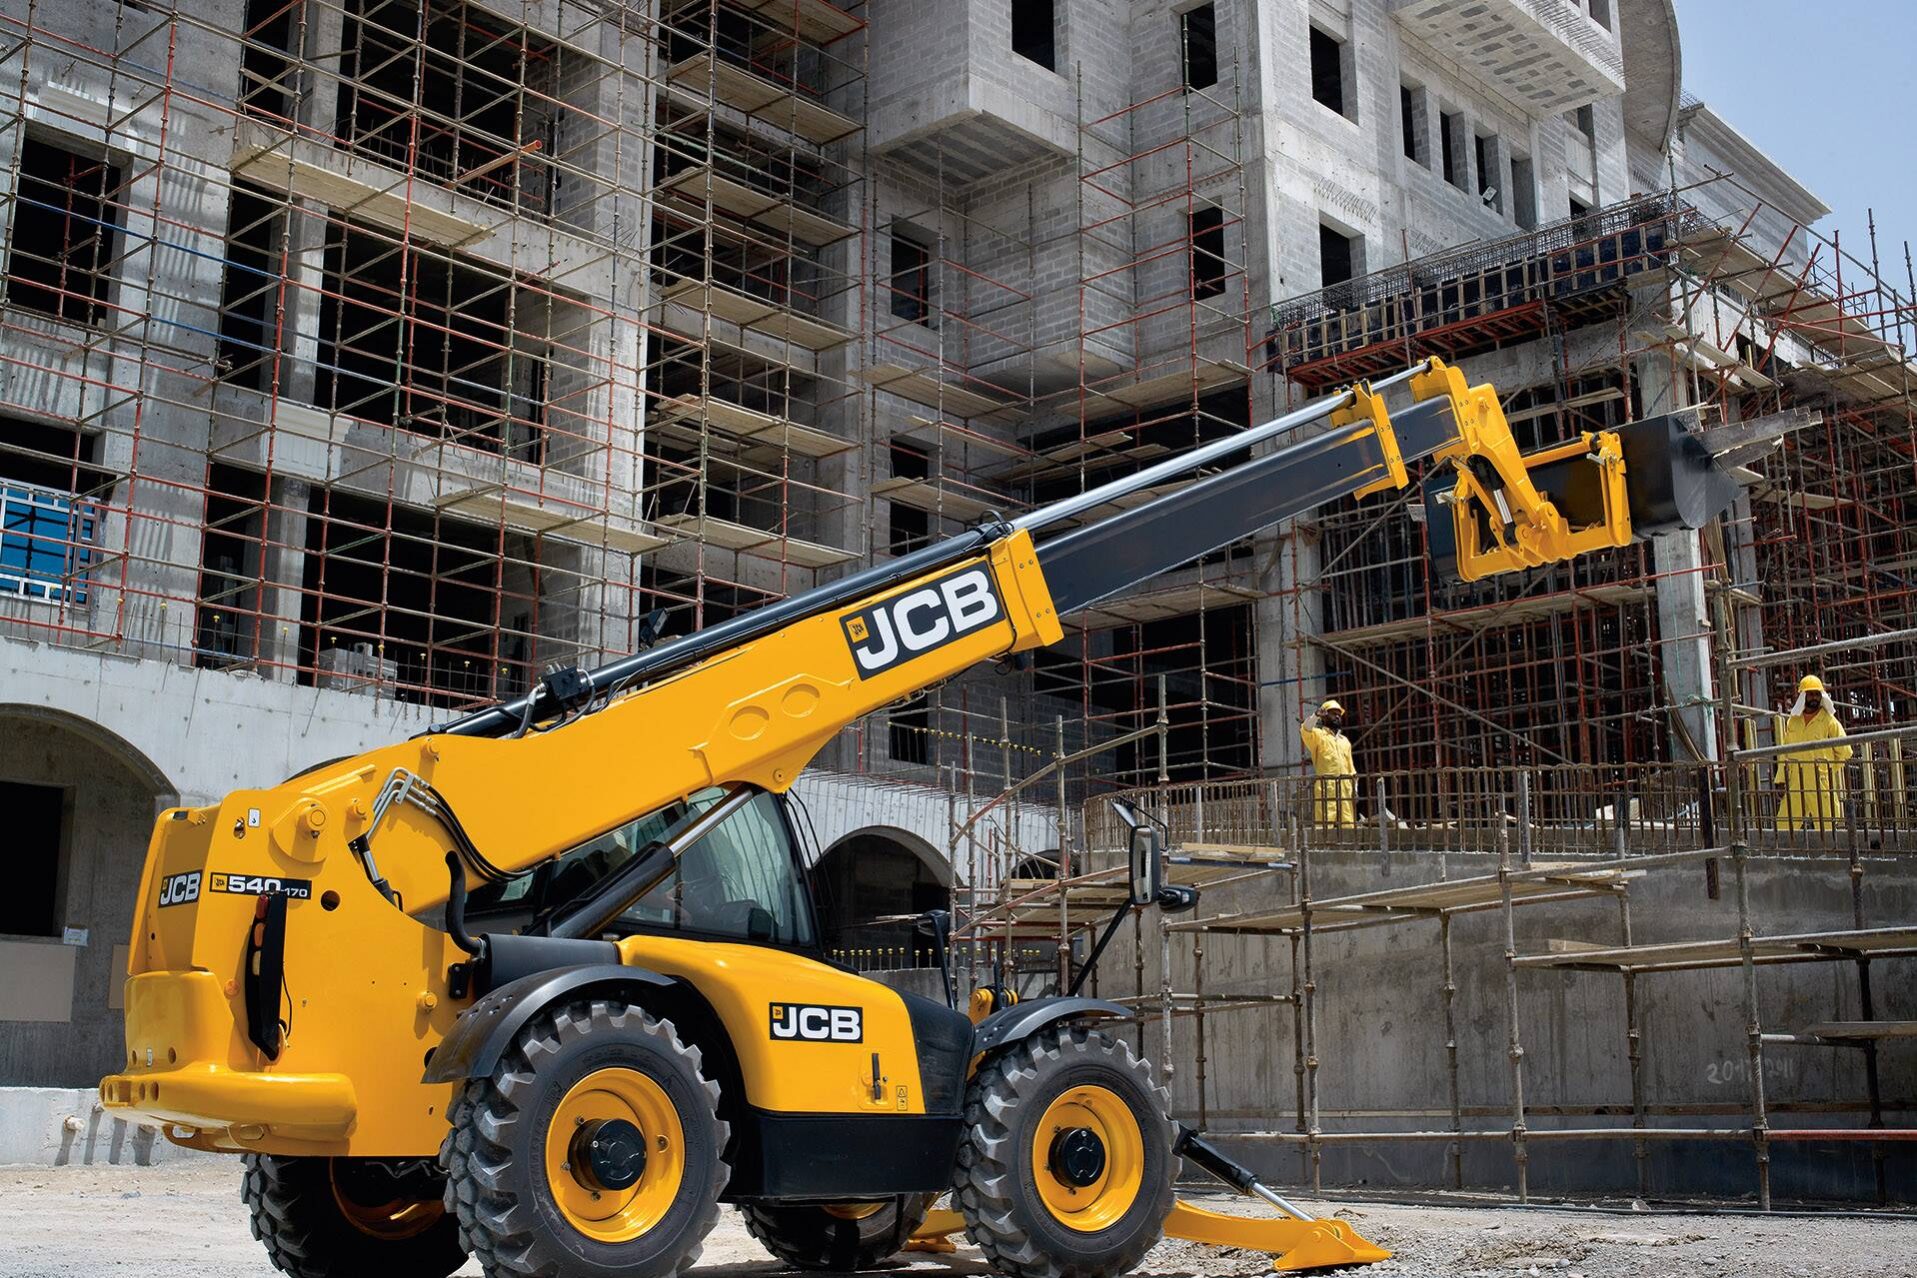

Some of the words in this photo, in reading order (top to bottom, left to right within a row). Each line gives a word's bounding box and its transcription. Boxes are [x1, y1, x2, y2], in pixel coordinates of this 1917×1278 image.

[856, 570, 997, 670] JCB
[160, 872, 201, 905] JCB
[773, 1006, 861, 1041] JCB
